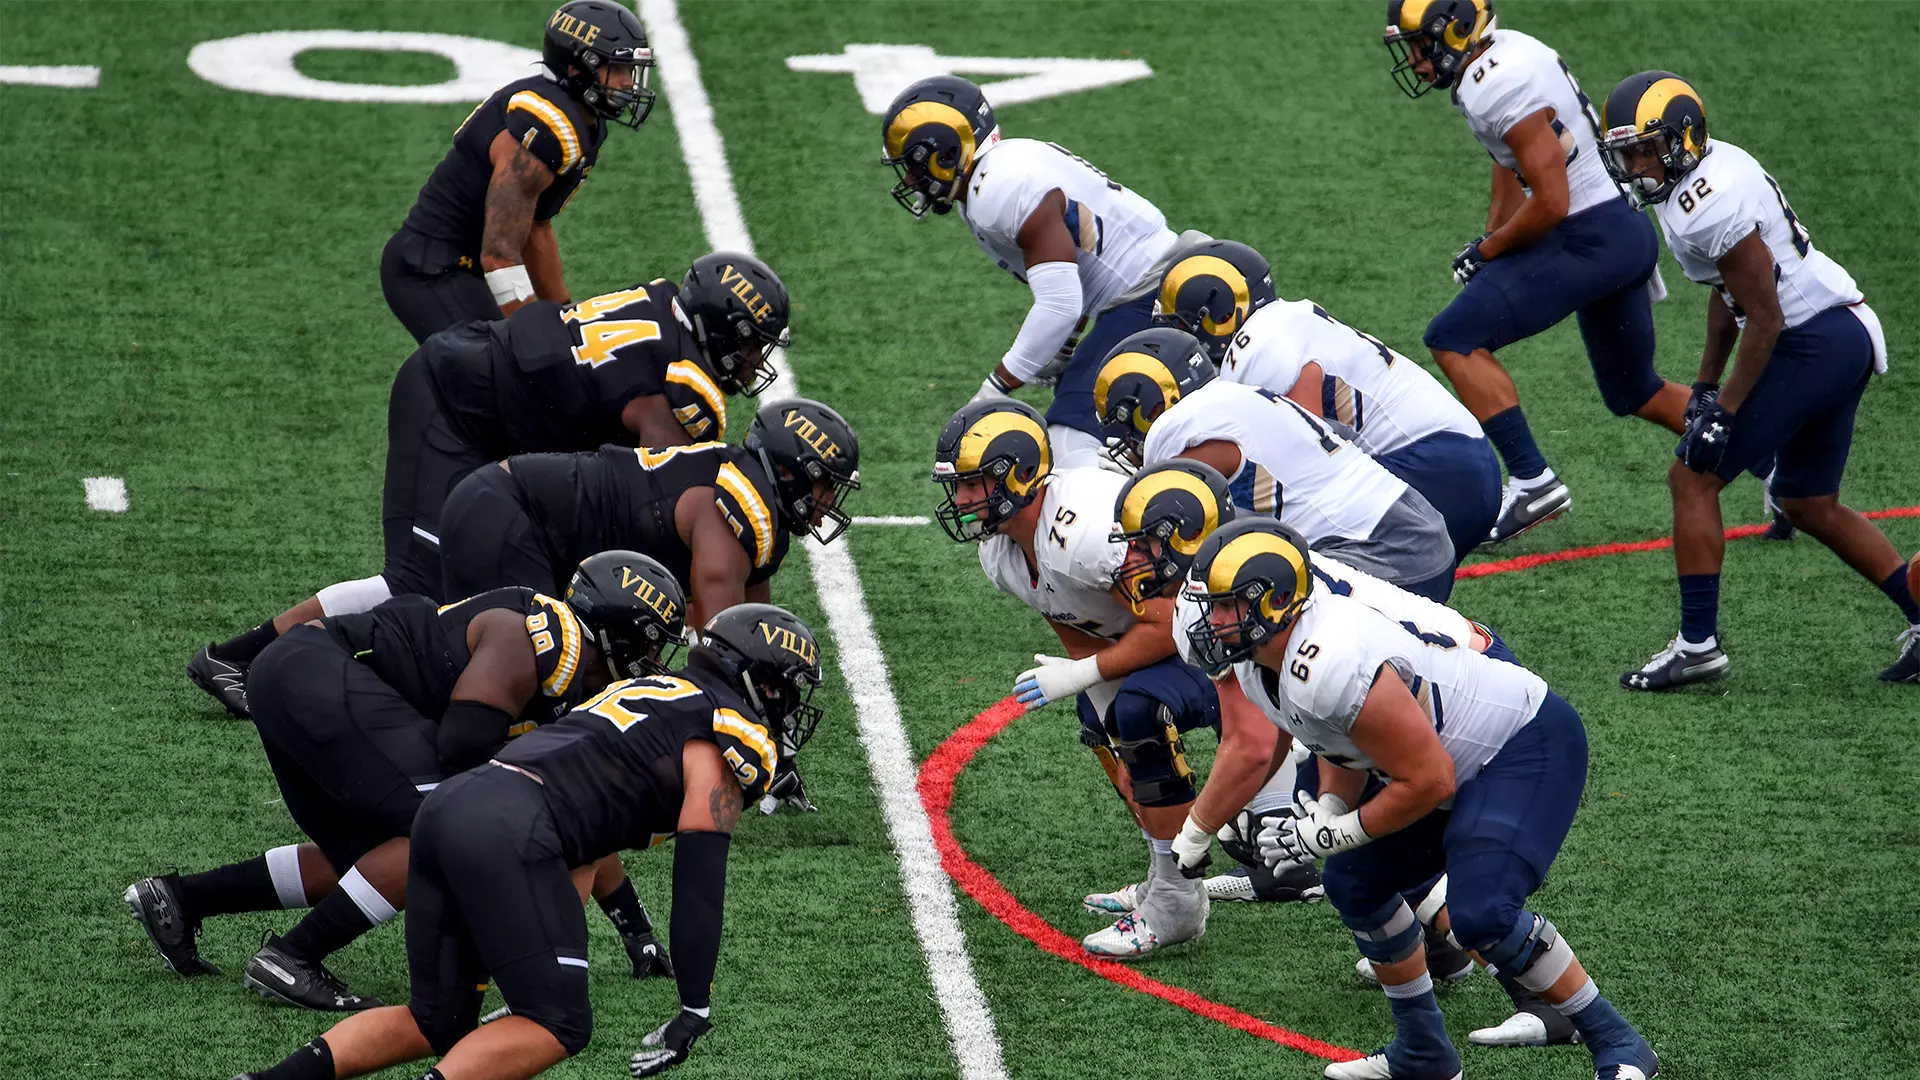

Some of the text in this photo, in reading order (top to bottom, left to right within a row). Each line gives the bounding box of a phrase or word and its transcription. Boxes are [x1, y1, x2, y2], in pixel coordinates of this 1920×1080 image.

[551, 10, 601, 47] VILLE
[1678, 176, 1713, 215] 82
[719, 264, 775, 324] VILLE
[560, 286, 661, 369] 44
[1225, 330, 1252, 372] 76
[784, 409, 841, 460] VILLE
[1049, 505, 1079, 551] 75
[620, 566, 678, 625] VILLE
[759, 621, 817, 666] VILLE
[1290, 638, 1321, 685] 65
[722, 745, 758, 790] 52
